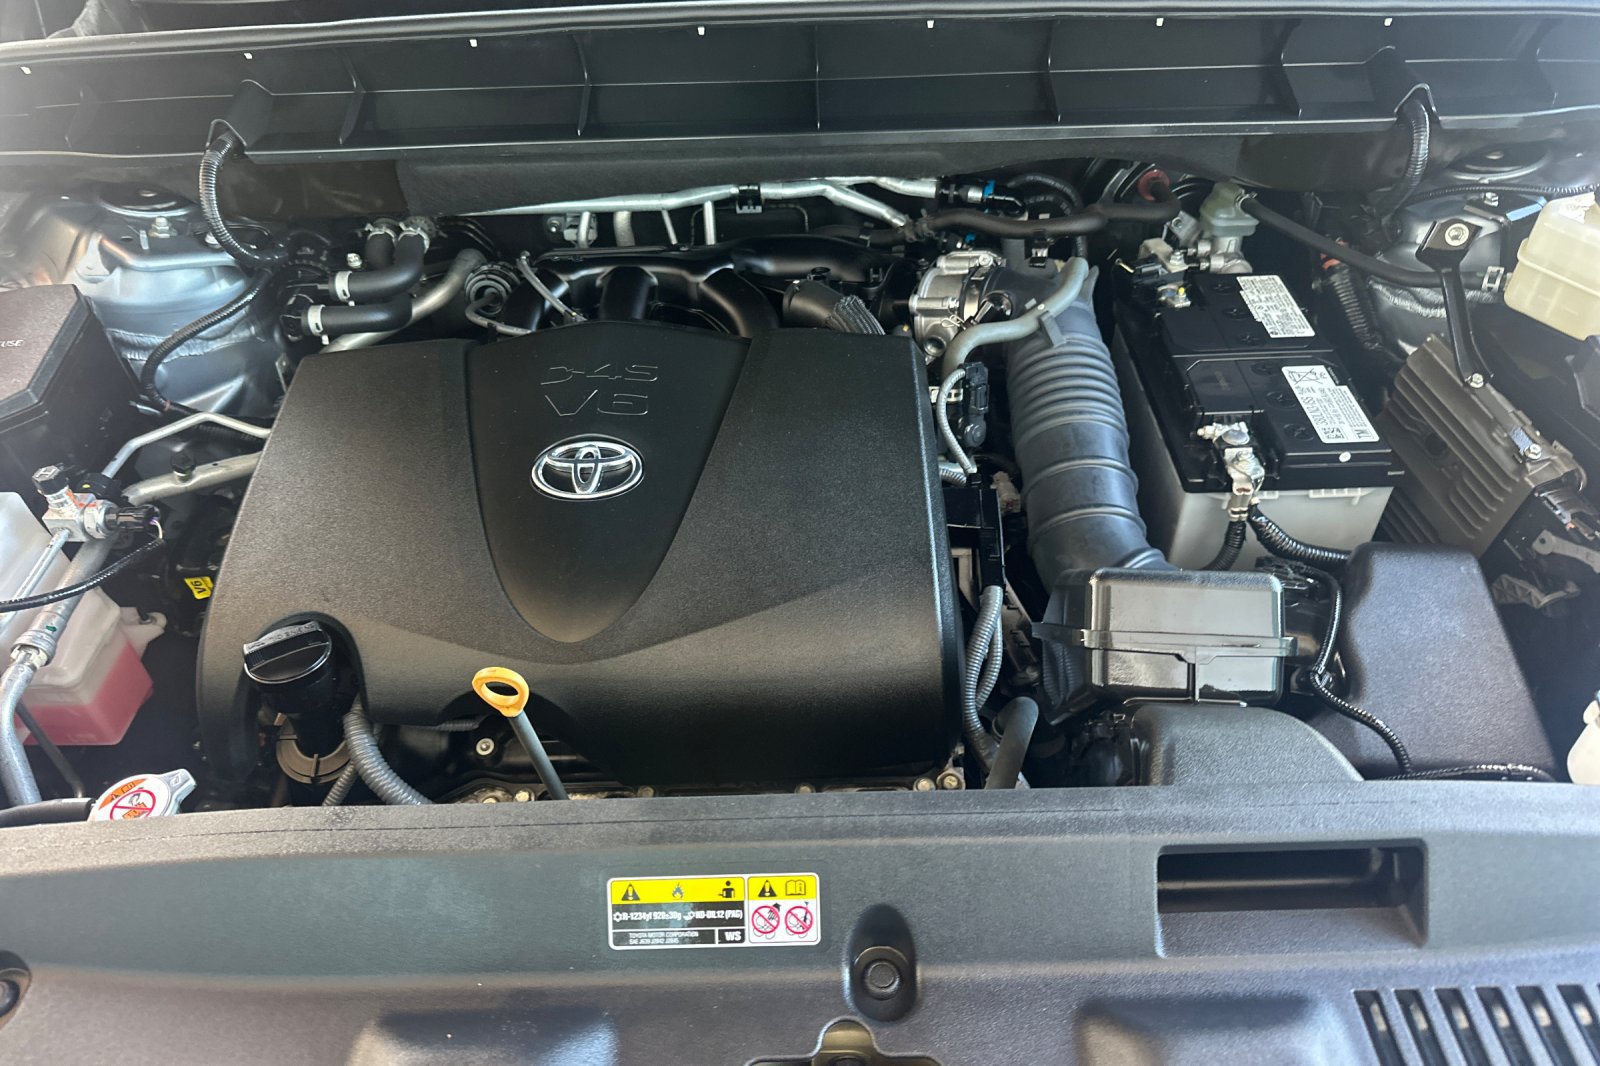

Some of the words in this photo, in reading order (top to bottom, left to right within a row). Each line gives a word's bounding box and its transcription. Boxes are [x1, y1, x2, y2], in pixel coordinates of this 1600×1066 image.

[0, 339, 24, 348] USE
[544, 389, 649, 417] V6
[191, 580, 208, 594] V6
[724, 931, 742, 941] WS
